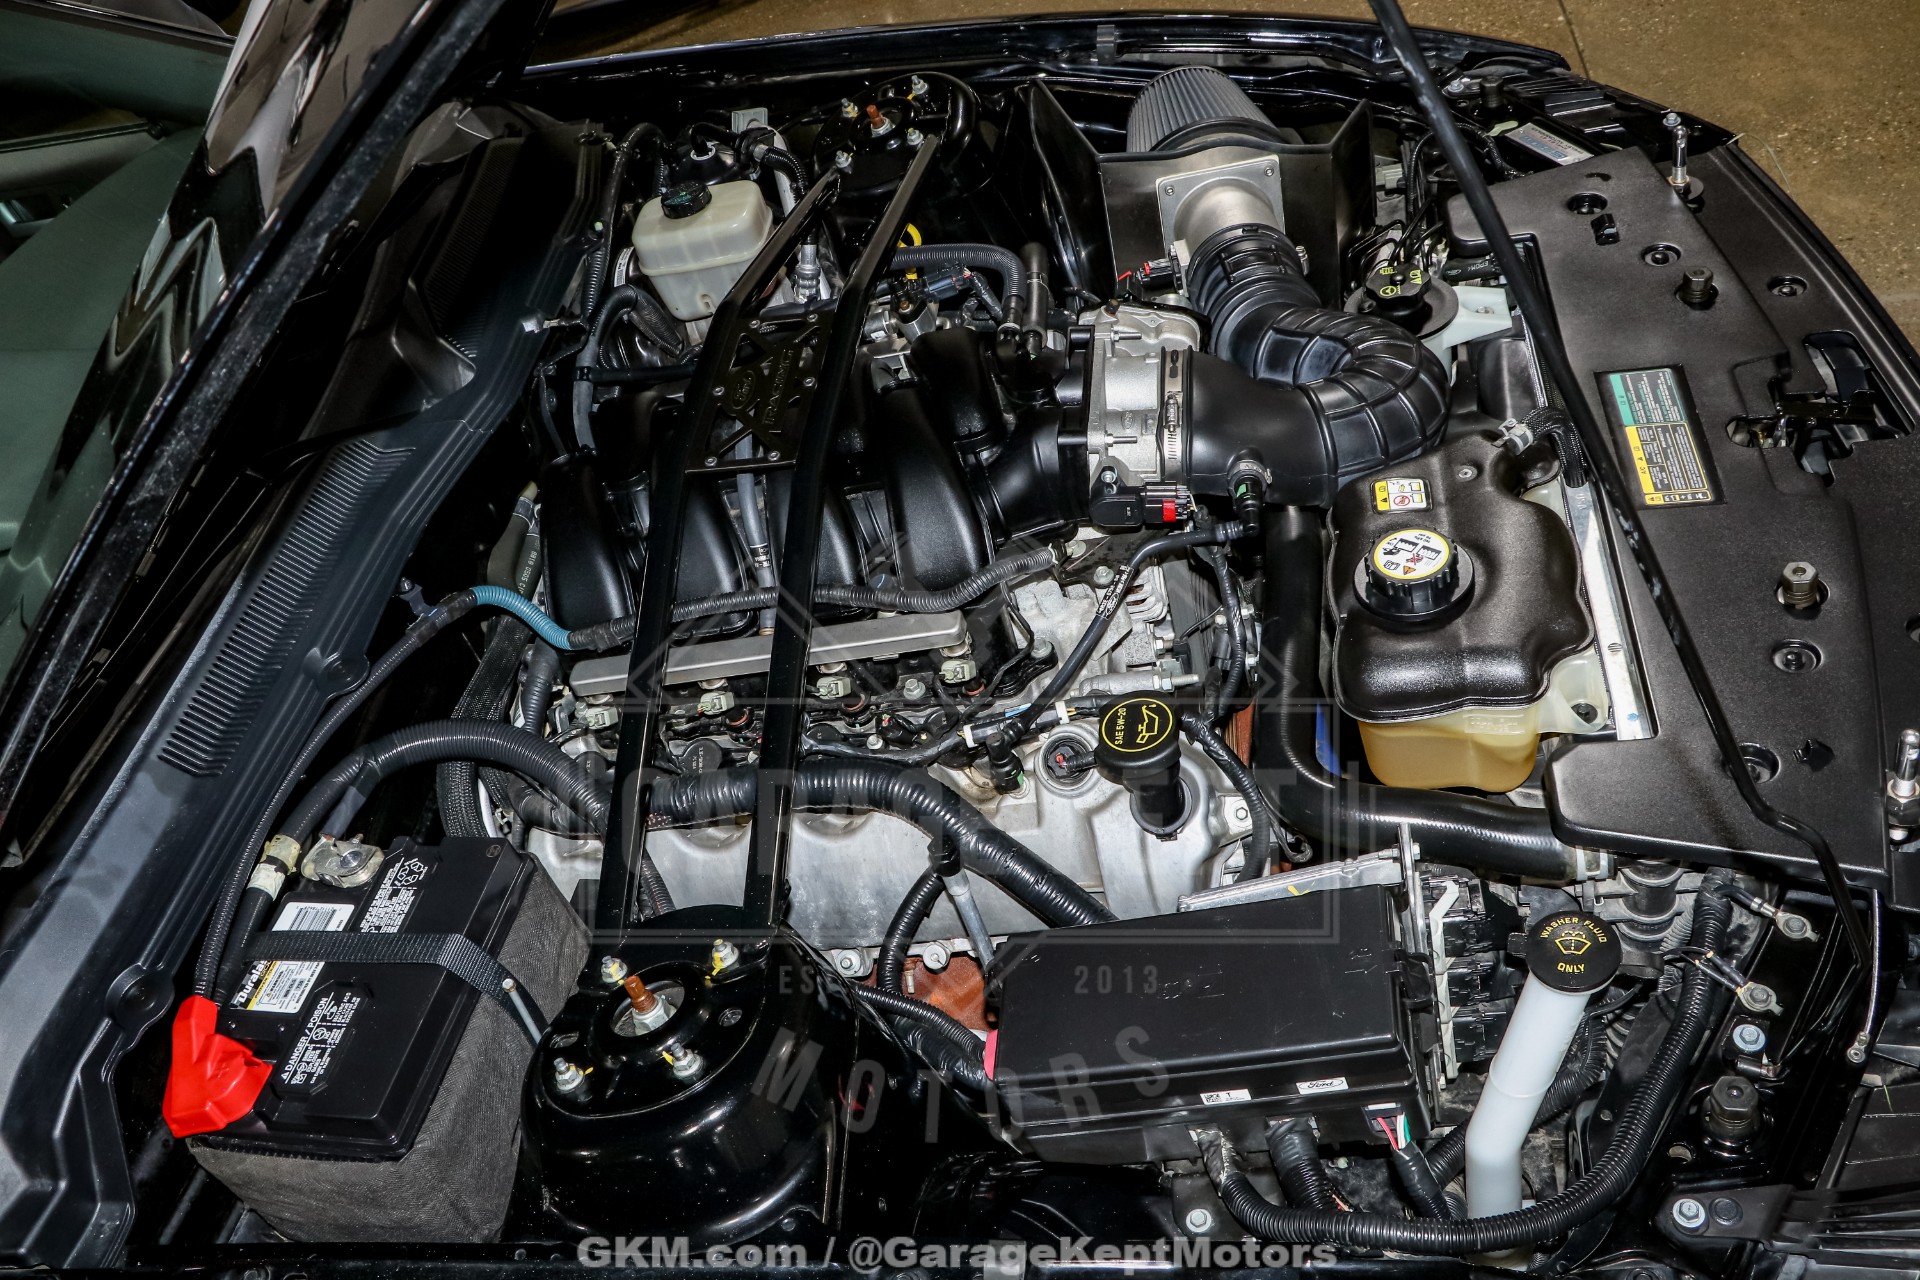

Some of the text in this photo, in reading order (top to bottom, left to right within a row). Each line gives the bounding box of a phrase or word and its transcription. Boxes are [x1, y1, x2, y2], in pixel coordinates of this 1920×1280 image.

[761, 347, 794, 426] RACING
[1115, 708, 1126, 744] SAE 5W-20
[1540, 918, 1608, 943] WASHER FLUID
[1557, 962, 1585, 973] ONLY
[284, 1036, 308, 1070] DANGER
[306, 998, 328, 1028] POISON
